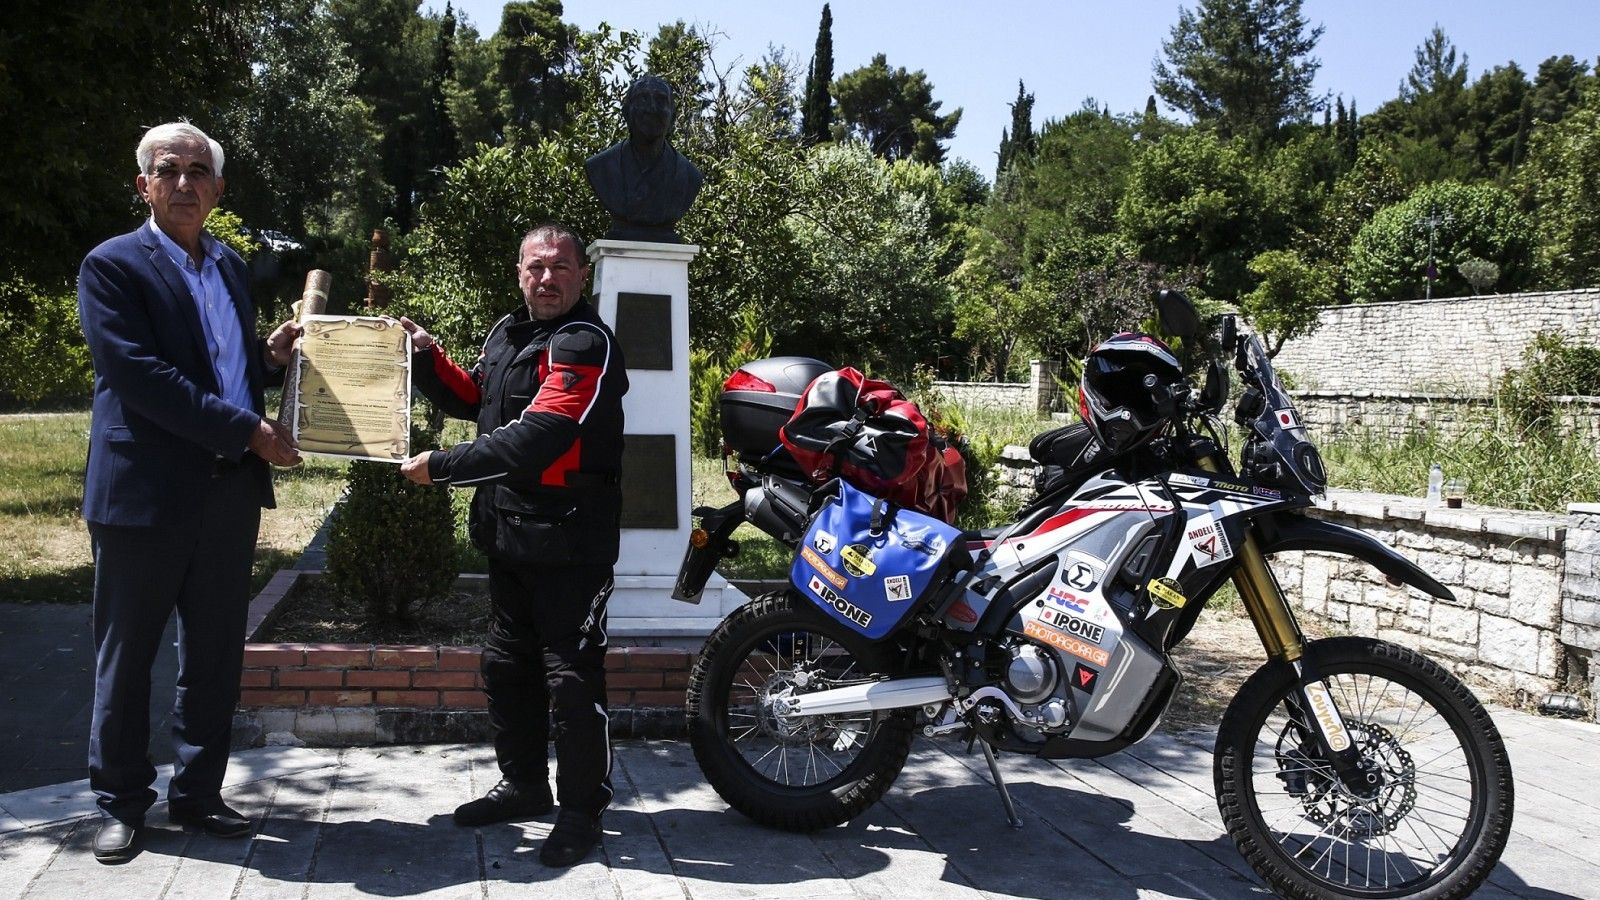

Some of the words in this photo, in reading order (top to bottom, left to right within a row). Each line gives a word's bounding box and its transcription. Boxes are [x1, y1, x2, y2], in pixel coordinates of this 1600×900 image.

[1188, 525, 1215, 540] ANDELI
[820, 585, 871, 627] IPONE
[1047, 587, 1090, 613] HRC
[1053, 612, 1102, 642] IPONE
